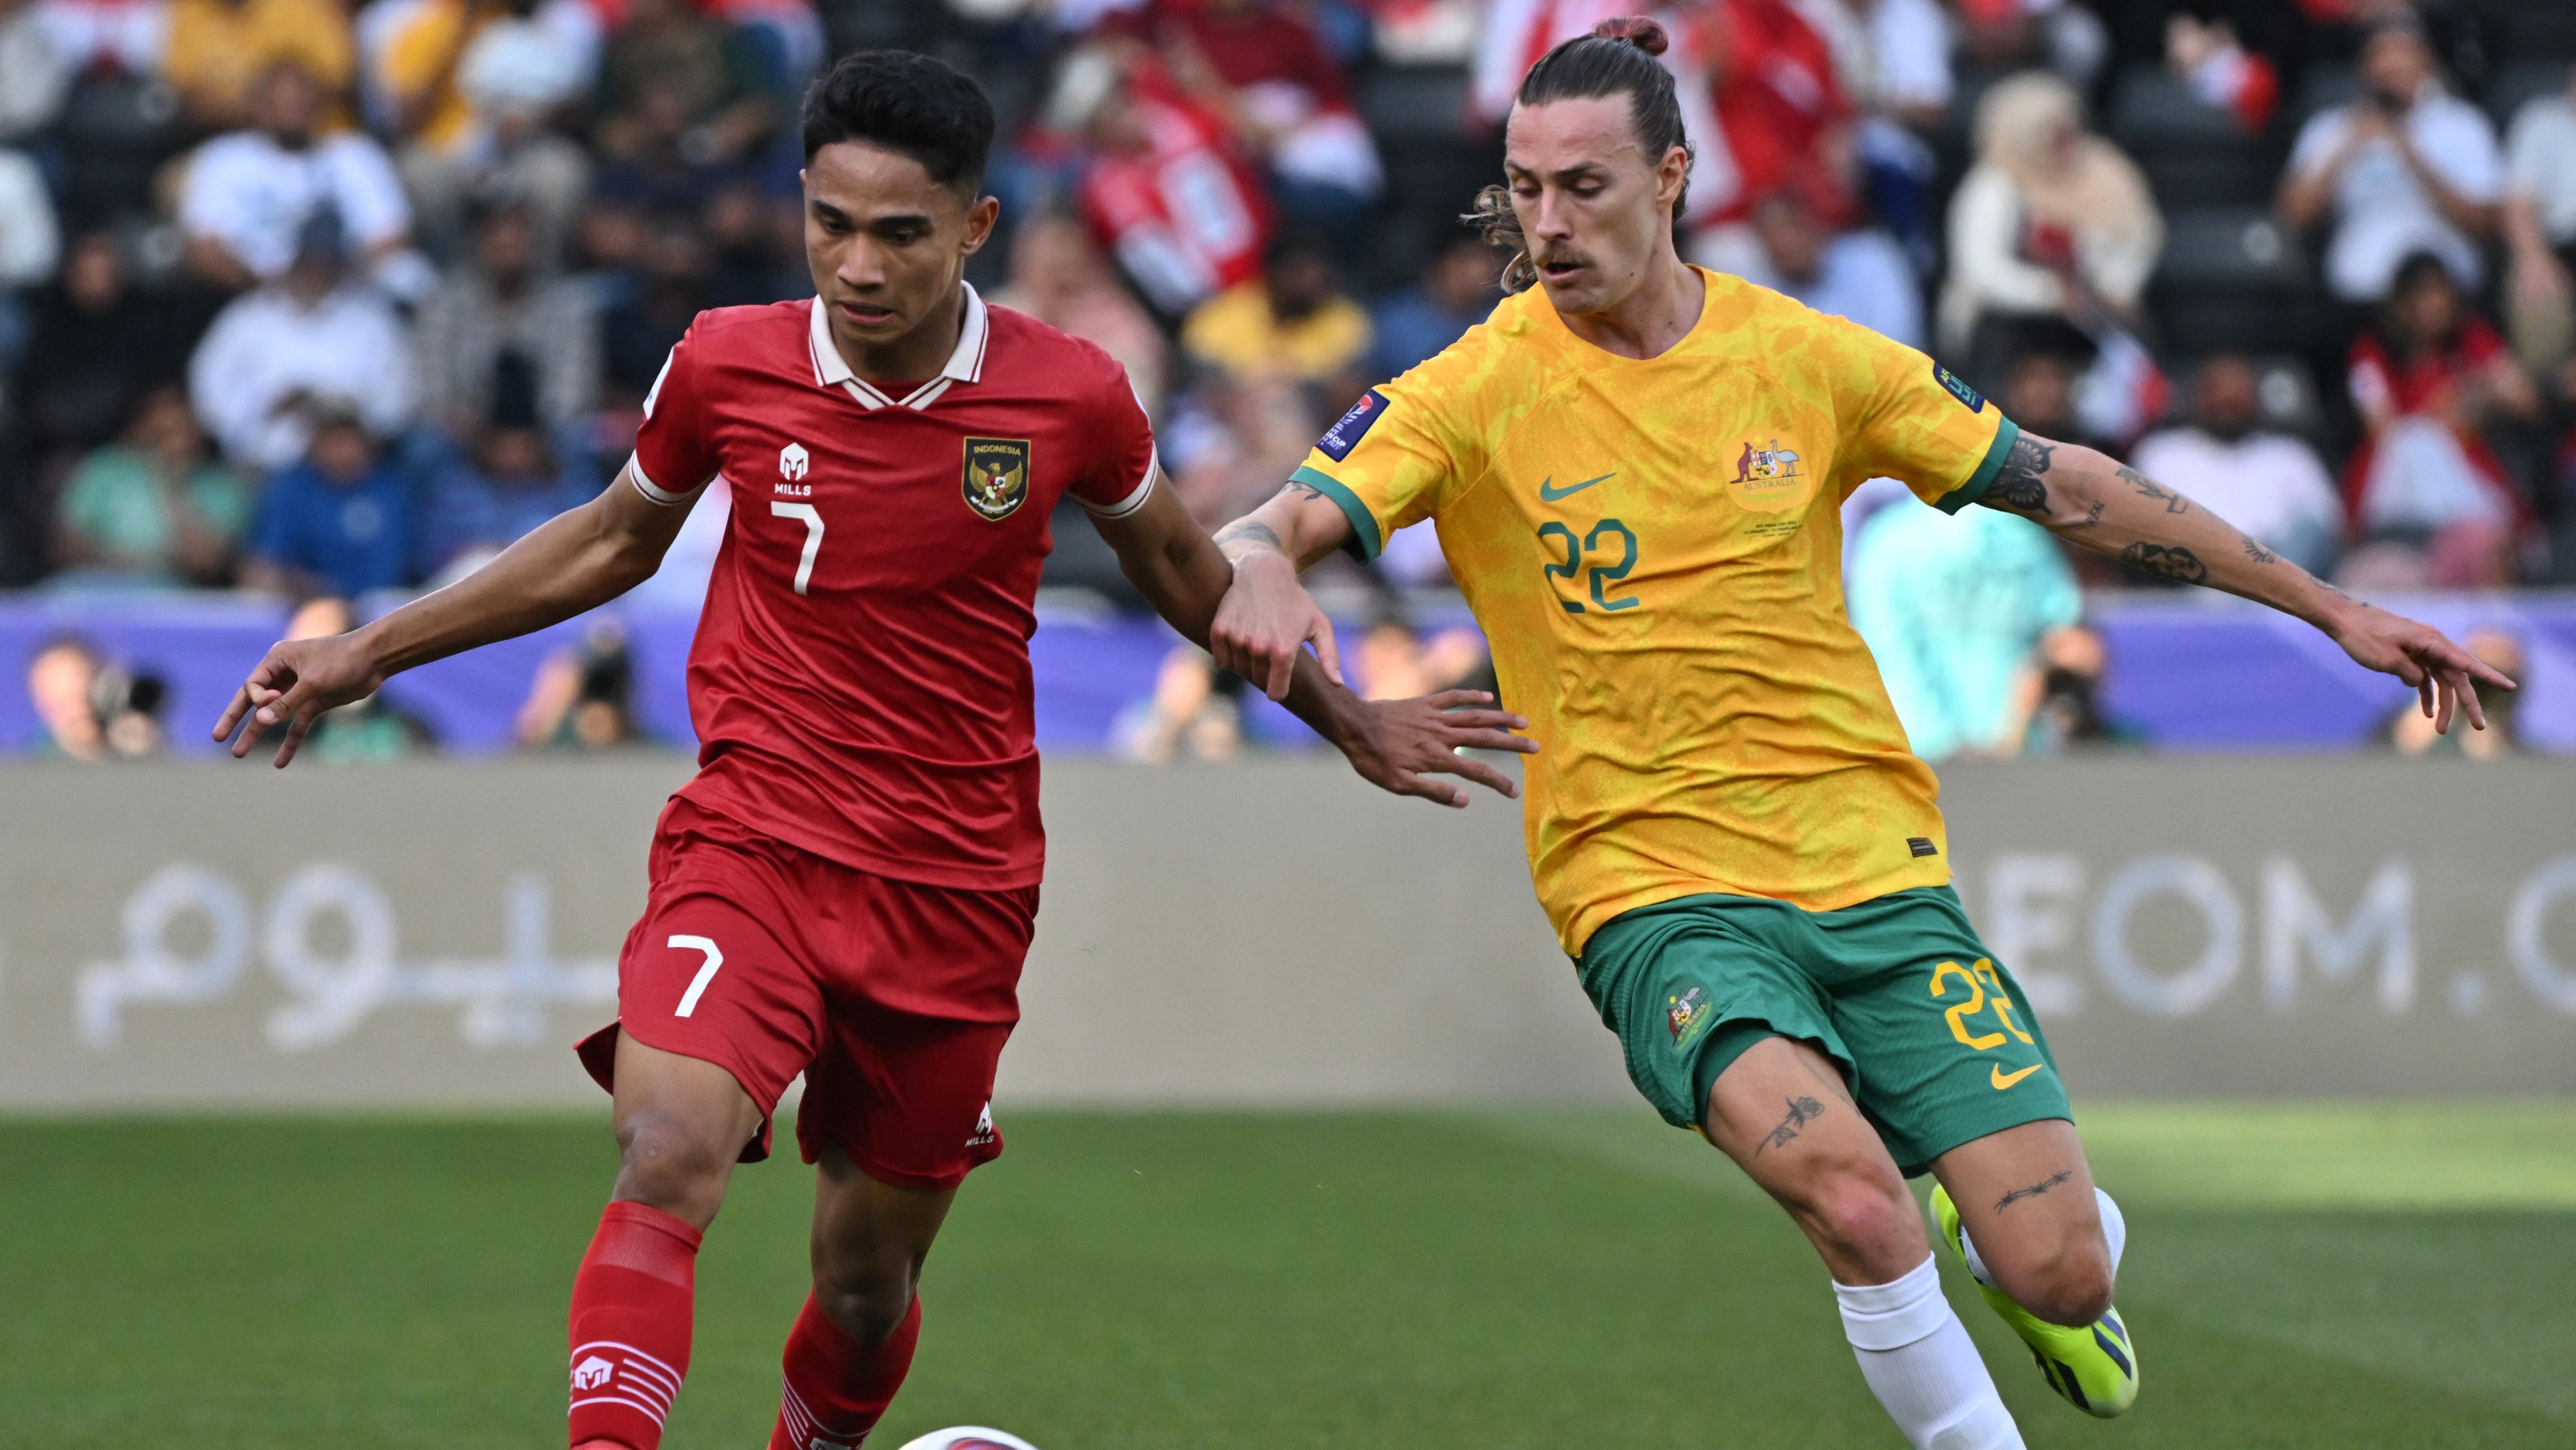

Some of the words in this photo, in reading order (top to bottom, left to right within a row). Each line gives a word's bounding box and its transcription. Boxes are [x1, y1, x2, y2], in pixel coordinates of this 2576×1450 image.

[1332, 436, 1346, 446] CUP
[973, 445, 1021, 455] INDONESIA
[774, 483, 811, 496] MILLS
[1744, 478, 1796, 490] AUSTRALIA
[771, 501, 825, 596] 7
[1537, 518, 1639, 613] 22
[667, 935, 723, 1018] 7
[1930, 957, 2034, 1050] 22
[964, 1135, 994, 1147] MILLS
